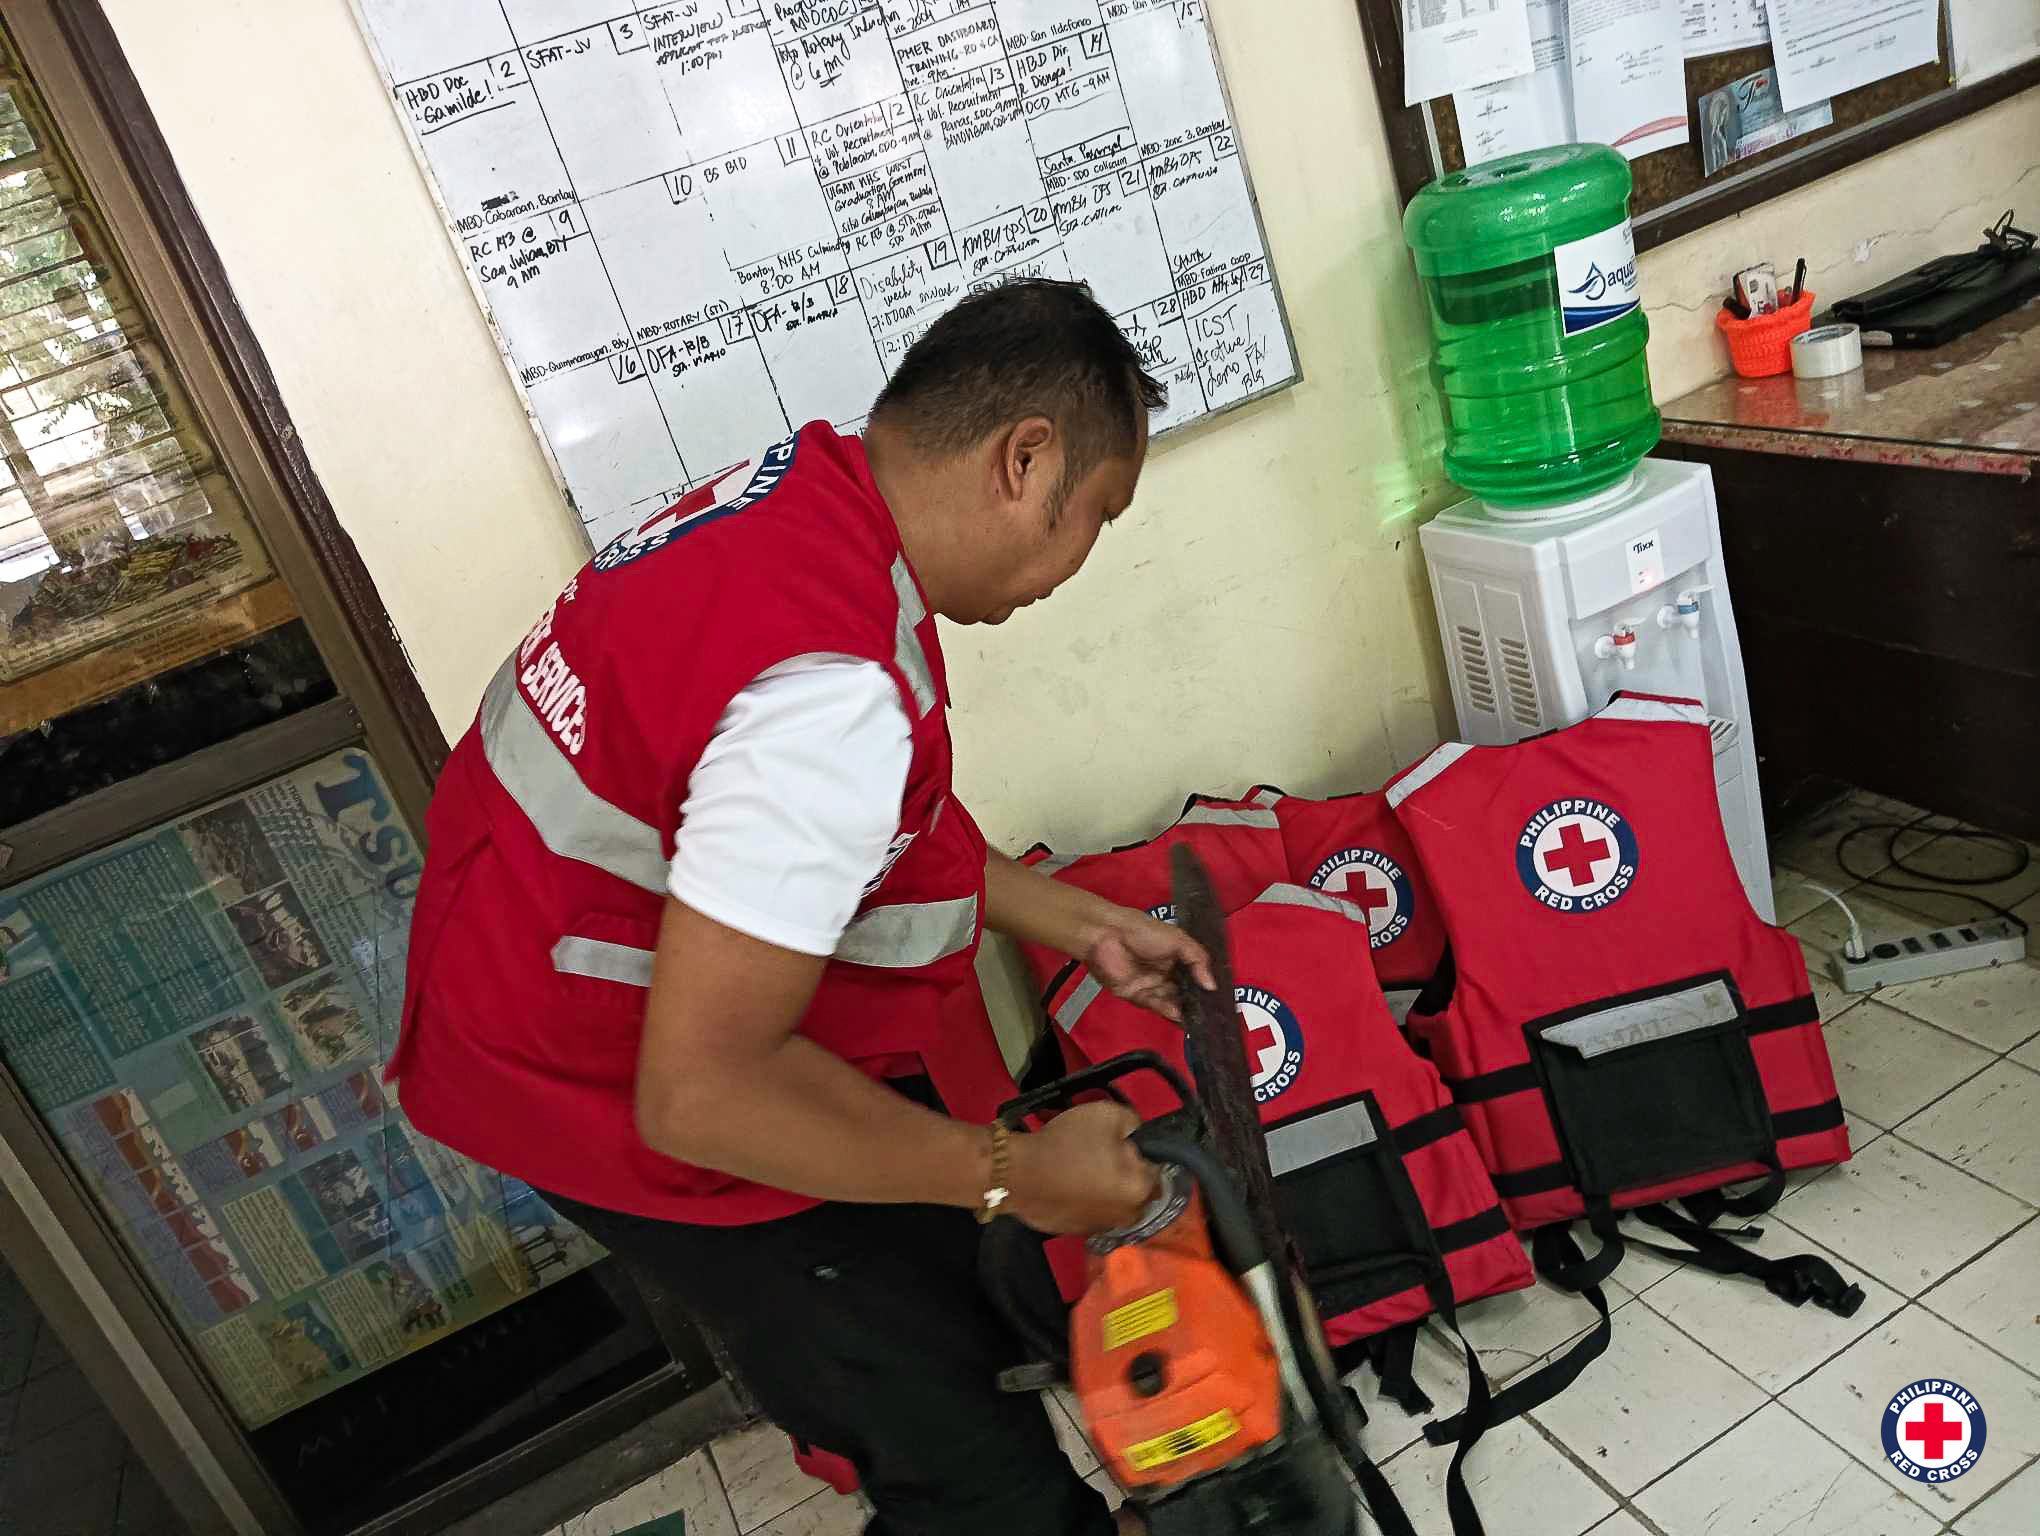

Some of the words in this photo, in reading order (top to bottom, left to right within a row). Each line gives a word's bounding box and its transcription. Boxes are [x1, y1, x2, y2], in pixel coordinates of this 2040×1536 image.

[620, 24, 633, 39] 3
[896, 41, 933, 64] PMER
[500, 61, 515, 78] 2
[989, 67, 1005, 85] 13
[1016, 52, 1046, 79] HBD
[405, 83, 439, 109] HBD
[888, 102, 904, 124] 12
[786, 138, 797, 158] 11
[811, 129, 831, 148] RC
[1214, 136, 1234, 151] 22
[675, 174, 691, 195] 10
[1121, 170, 1140, 185] 21
[559, 210, 575, 233] 9
[1027, 208, 1047, 223] 20
[470, 242, 492, 262] RC
[777, 248, 803, 270] NHS
[934, 243, 947, 262] 19
[507, 275, 518, 288] 9
[1248, 264, 1264, 280] 29
[834, 276, 848, 298] 18
[1158, 299, 1175, 316] 28
[727, 315, 744, 339] 17
[617, 353, 637, 378] 16
[520, 641, 586, 755] SERVICES
[1519, 800, 1621, 849] PHILIPPINE
[1310, 849, 1402, 888] PHILIPPINE
[1534, 885, 1573, 911] RED
[1580, 864, 1634, 911] CROSS
[1370, 914, 1408, 948] ROSS
[1254, 1050, 1301, 1102] CROSS
